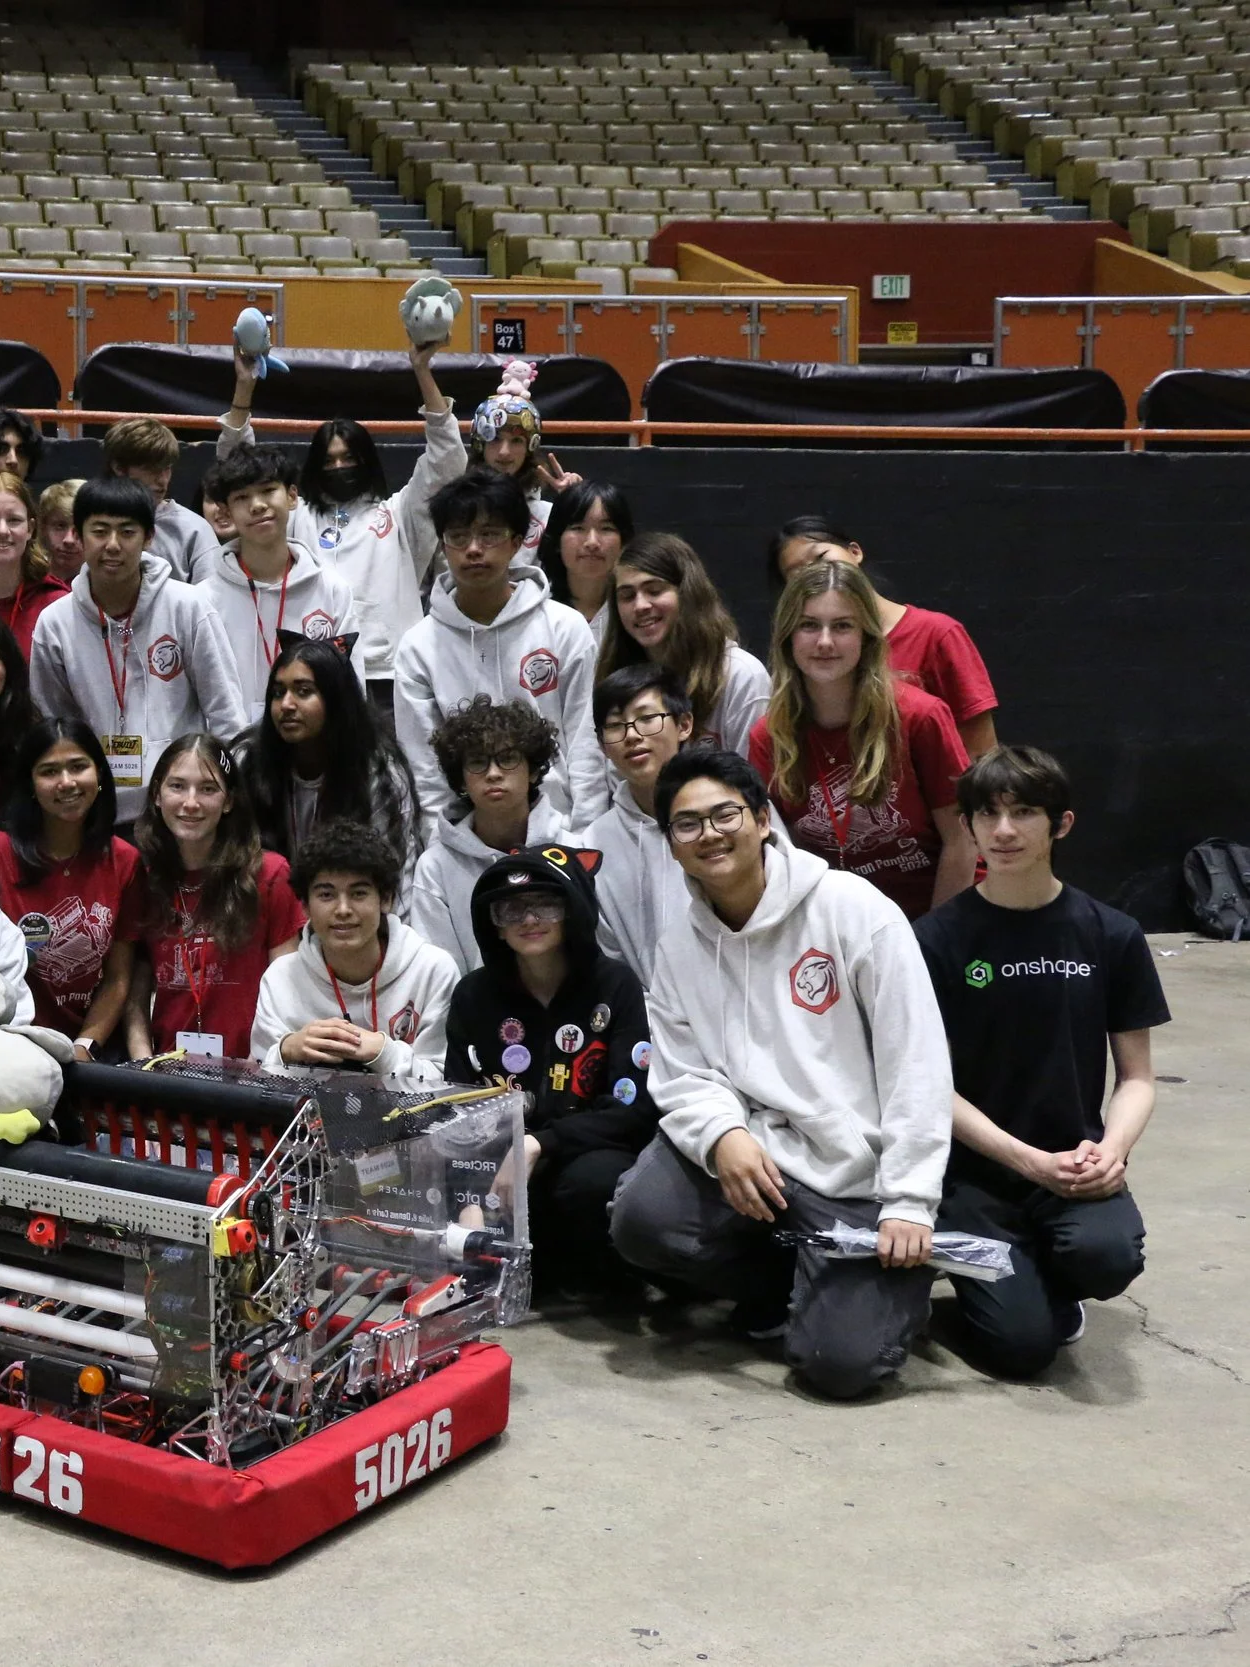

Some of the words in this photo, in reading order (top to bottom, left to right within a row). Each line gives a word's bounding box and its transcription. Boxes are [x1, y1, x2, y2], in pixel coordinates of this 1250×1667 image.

[881, 276, 904, 296] EXIT
[495, 323, 515, 334] Box
[497, 336, 514, 348] 47
[874, 849, 927, 869] Panthers
[898, 858, 931, 873] 5026
[1001, 957, 1091, 978] onshape
[355, 1408, 452, 1512] 5026
